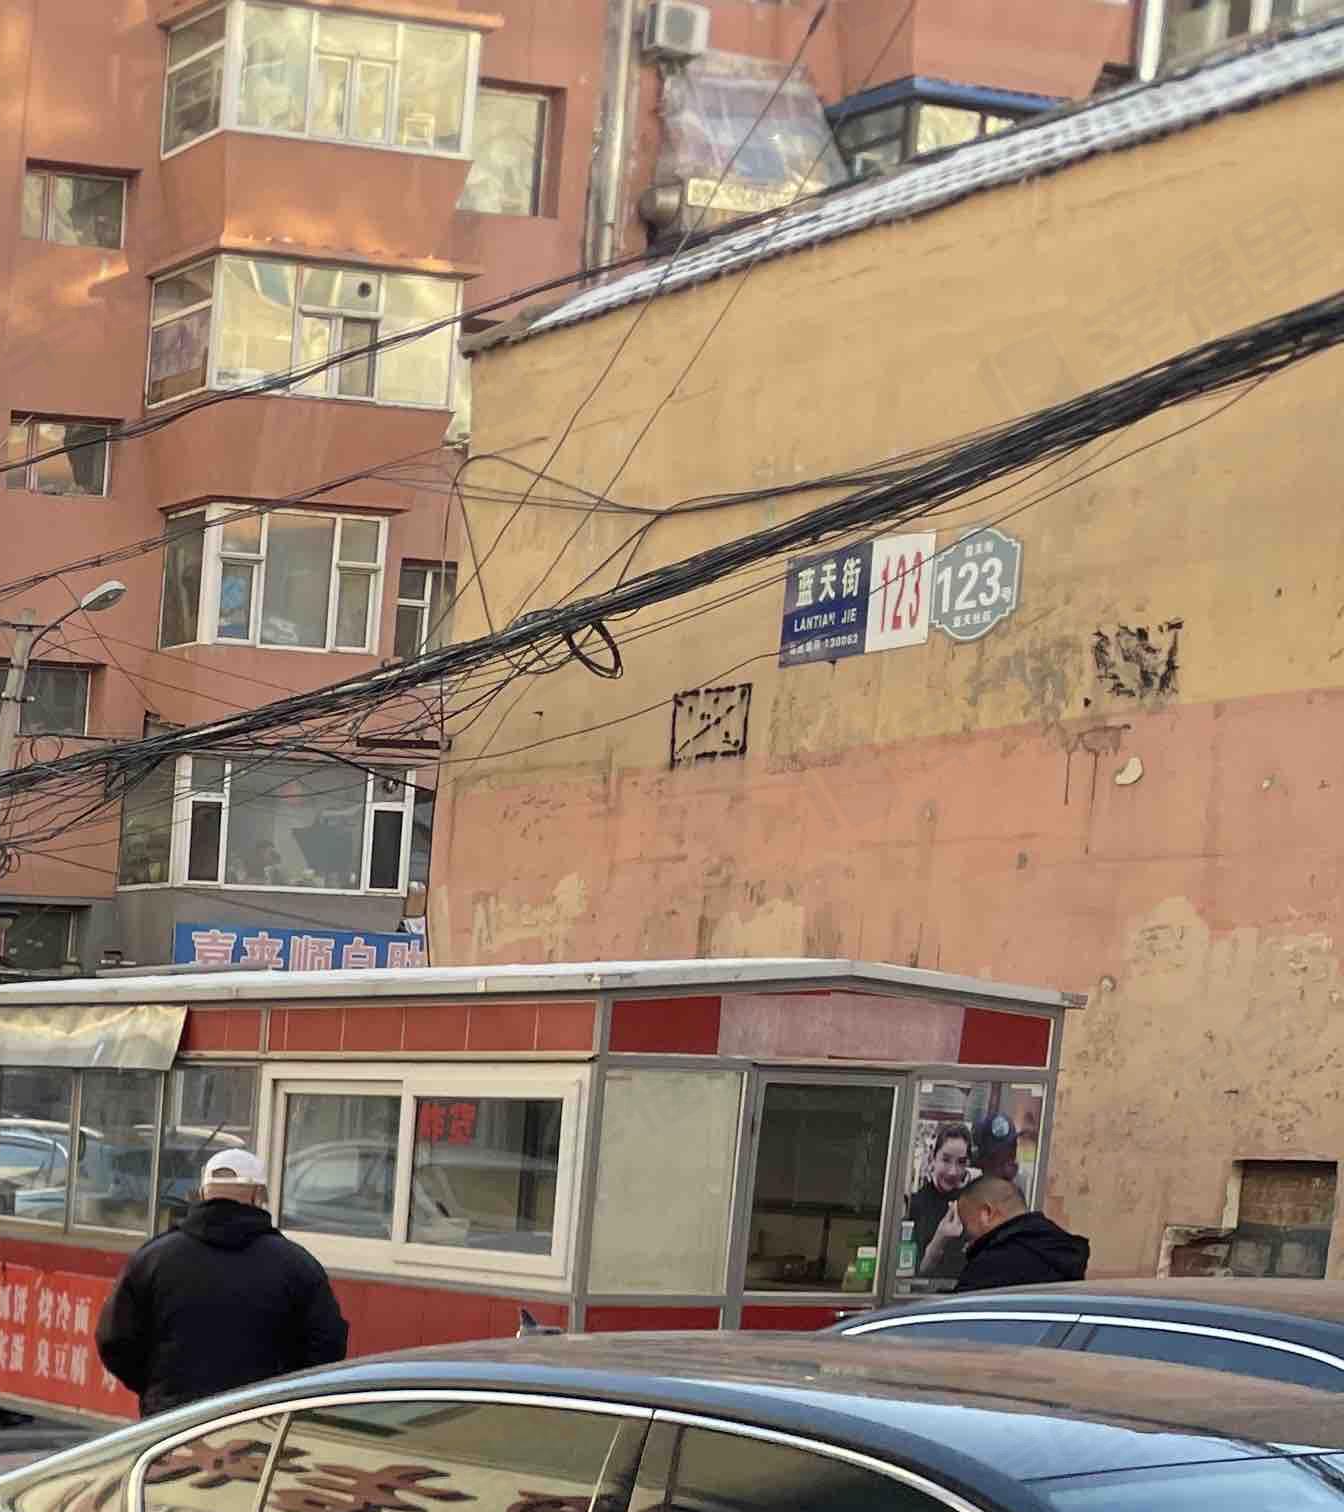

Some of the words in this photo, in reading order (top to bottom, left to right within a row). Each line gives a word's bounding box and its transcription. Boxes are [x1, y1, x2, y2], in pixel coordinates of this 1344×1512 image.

[795, 556, 862, 607] 蓝天街
[879, 549, 923, 634] 123
[793, 611, 836, 633] LANTIAN
[840, 607, 858, 625] JIE
